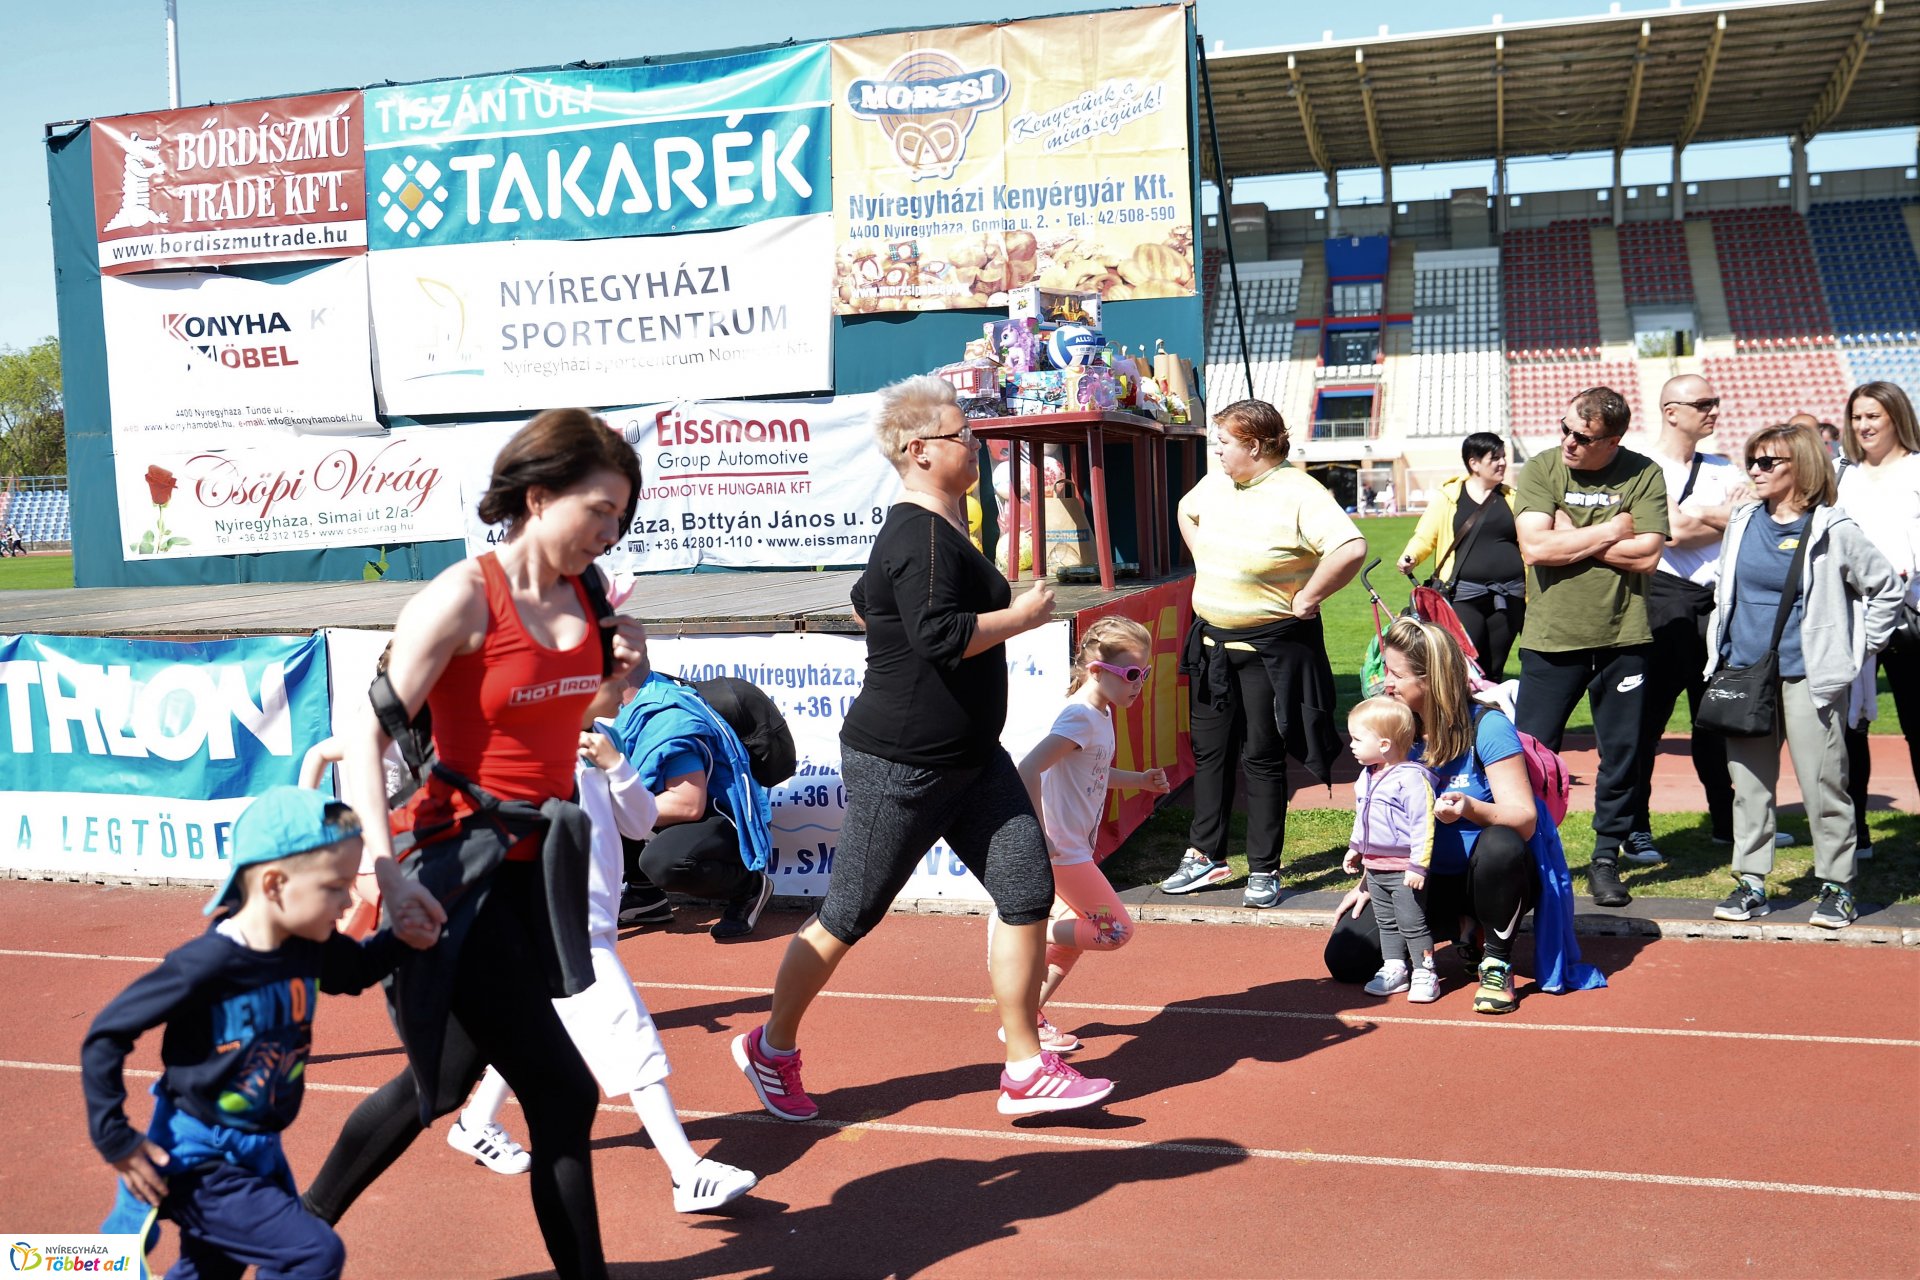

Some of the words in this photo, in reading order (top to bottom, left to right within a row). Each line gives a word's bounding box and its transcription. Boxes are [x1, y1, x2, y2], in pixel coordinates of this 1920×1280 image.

[375, 78, 593, 133] TISZÁNTÚLI
[861, 74, 995, 111] MORZSI
[1013, 85, 1115, 138] Kenyerünk
[1124, 83, 1134, 94] a
[1047, 86, 1161, 149] minőségünk!
[176, 104, 350, 171] BŐRDÍSZMŰ
[449, 115, 813, 225] TAKARÉK
[177, 177, 275, 223] TRADE
[283, 171, 348, 216] KFT.
[850, 187, 983, 221] Nyíregyházi
[993, 177, 1125, 211] Kenyérgyár
[1134, 174, 1173, 201] Kft.
[850, 224, 879, 239] 4400
[972, 217, 1015, 232] Gomba
[1021, 219, 1031, 229] u.
[1037, 214, 1048, 228] 2.
[1067, 212, 1093, 226] Tel.:
[1098, 205, 1175, 224] 42/508-590
[112, 227, 347, 259] www.bordiszmutrade.hu
[501, 262, 731, 307] NYÍREGYHÁZI
[163, 312, 291, 341] KONYHA
[501, 304, 788, 351] SPORTCENTRUM
[656, 409, 810, 447] Eissmann
[657, 451, 711, 471] Group
[718, 449, 809, 466] Automotive
[184, 454, 307, 519] Csöpi
[314, 439, 443, 513] Virág
[637, 482, 714, 501] AUTOMOTVE
[718, 481, 786, 496] HUNGARIA
[791, 480, 812, 494] KFT
[318, 509, 362, 525] Simai
[682, 510, 761, 533] Bottyán
[768, 509, 836, 529] János
[843, 511, 863, 526] u.
[655, 537, 678, 550] +36
[682, 534, 752, 549] 42801-110
[766, 533, 877, 548] www.eissmann
[516, 684, 557, 702] HOT
[563, 679, 601, 692] IRON
[679, 664, 727, 684] 4400
[734, 663, 862, 689] Nyíregyháza,
[794, 696, 832, 718] +36
[790, 785, 829, 808] +36
[17, 815, 32, 850] A
